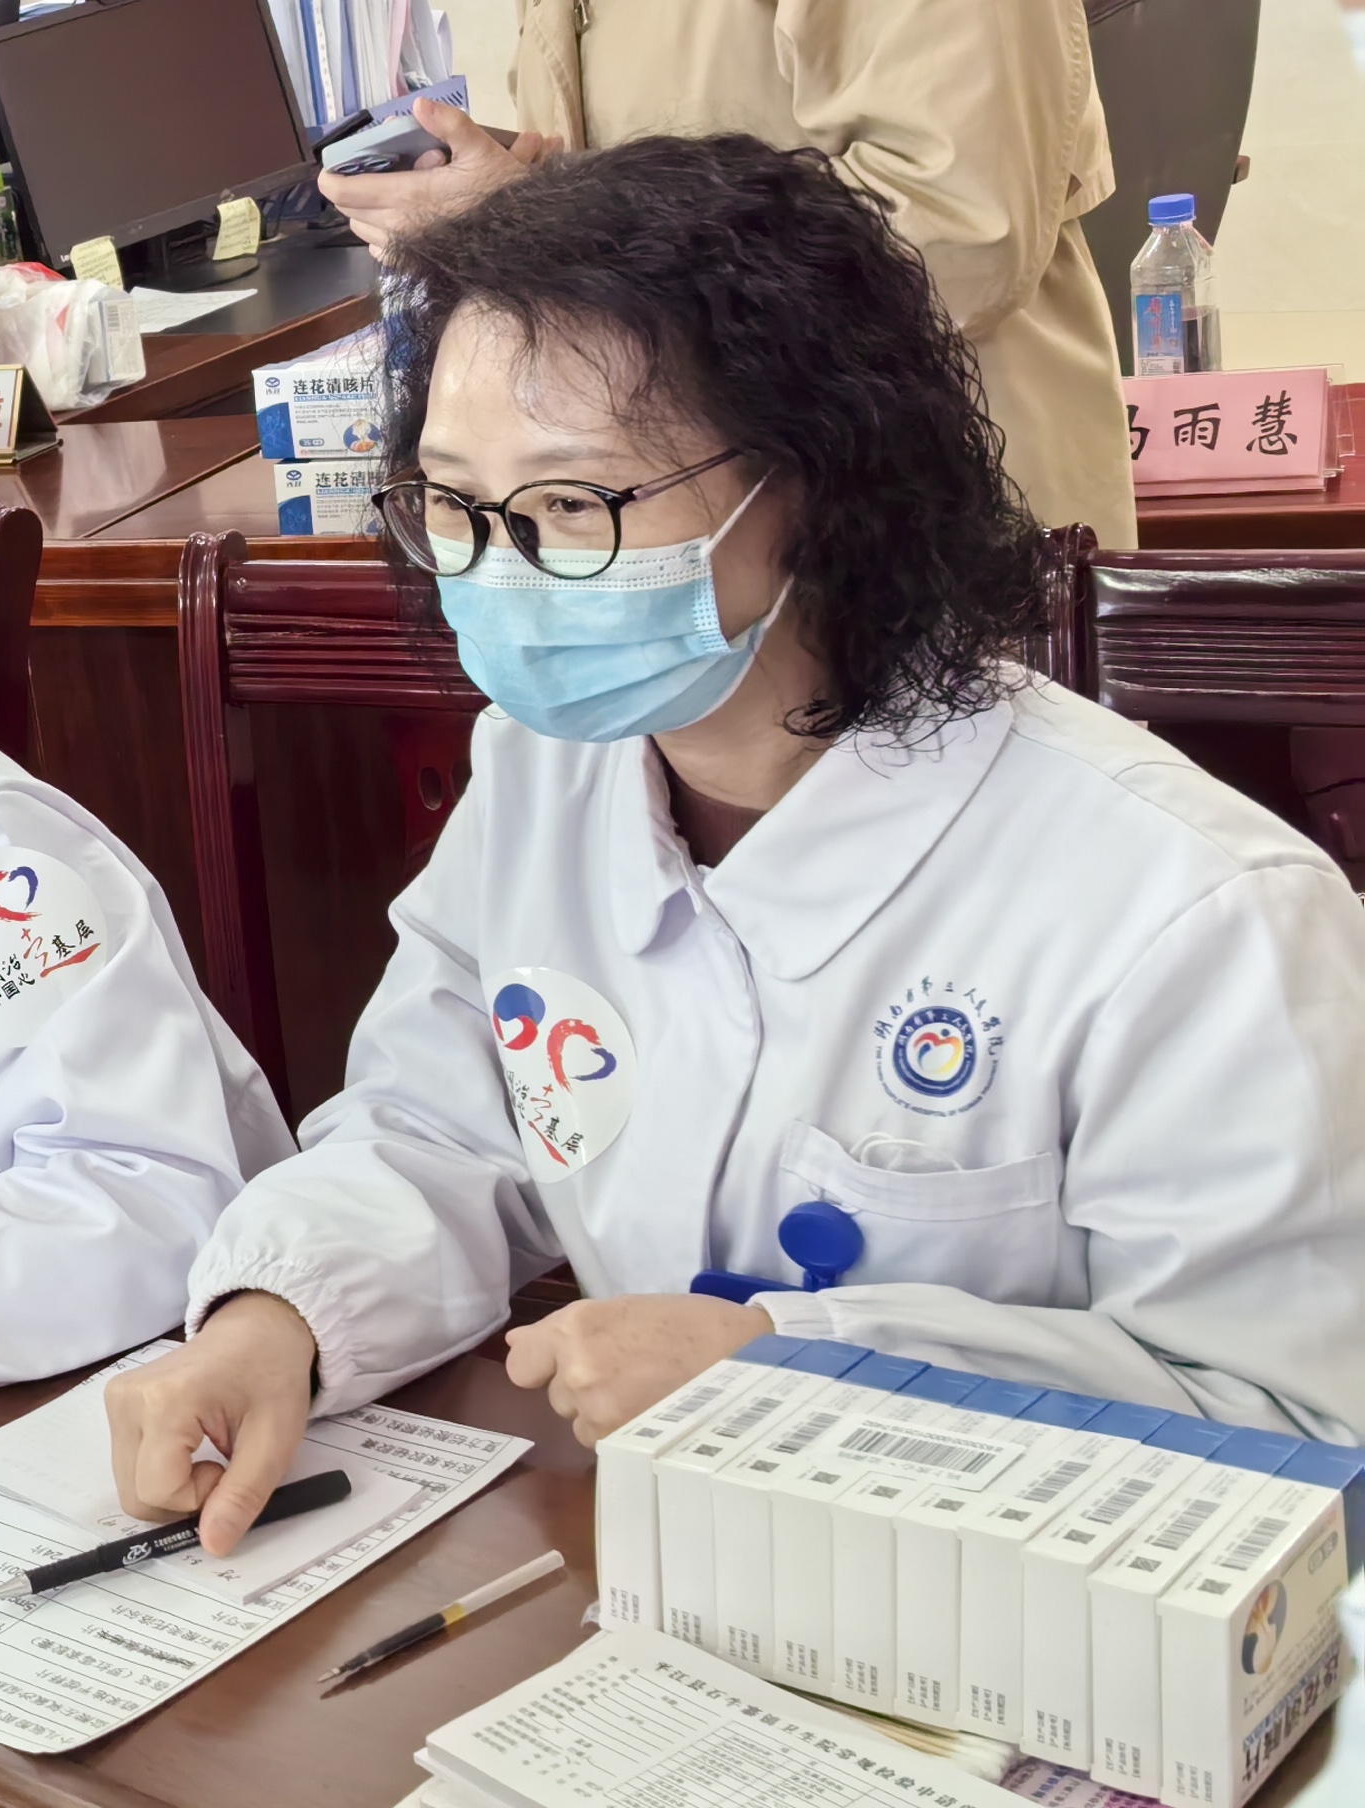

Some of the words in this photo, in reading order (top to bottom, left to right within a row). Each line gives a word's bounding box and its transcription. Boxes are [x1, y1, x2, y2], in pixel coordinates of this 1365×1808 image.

[293, 376, 375, 395] 连花清咳片
